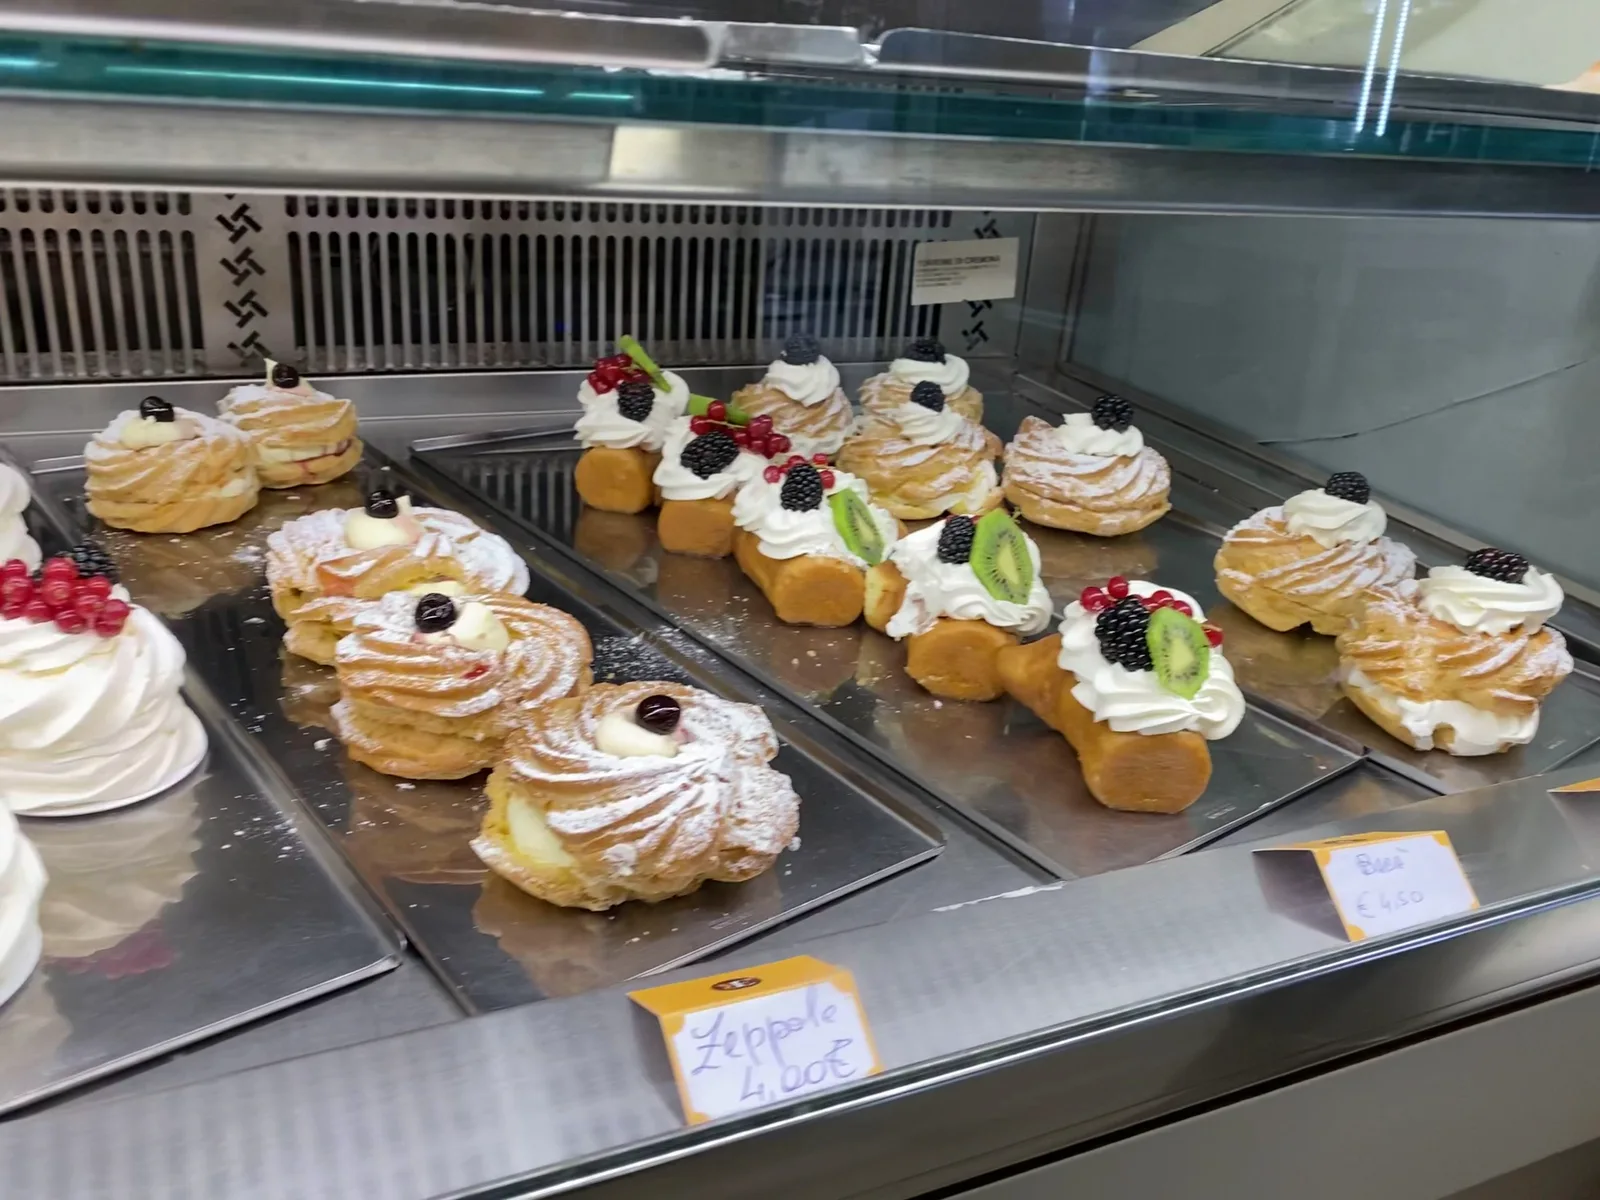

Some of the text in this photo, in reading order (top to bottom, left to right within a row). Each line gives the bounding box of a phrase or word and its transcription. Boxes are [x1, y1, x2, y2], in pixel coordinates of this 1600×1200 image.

[1357, 890, 1424, 918] € 4,50
[691, 986, 838, 1076] Zeppole
